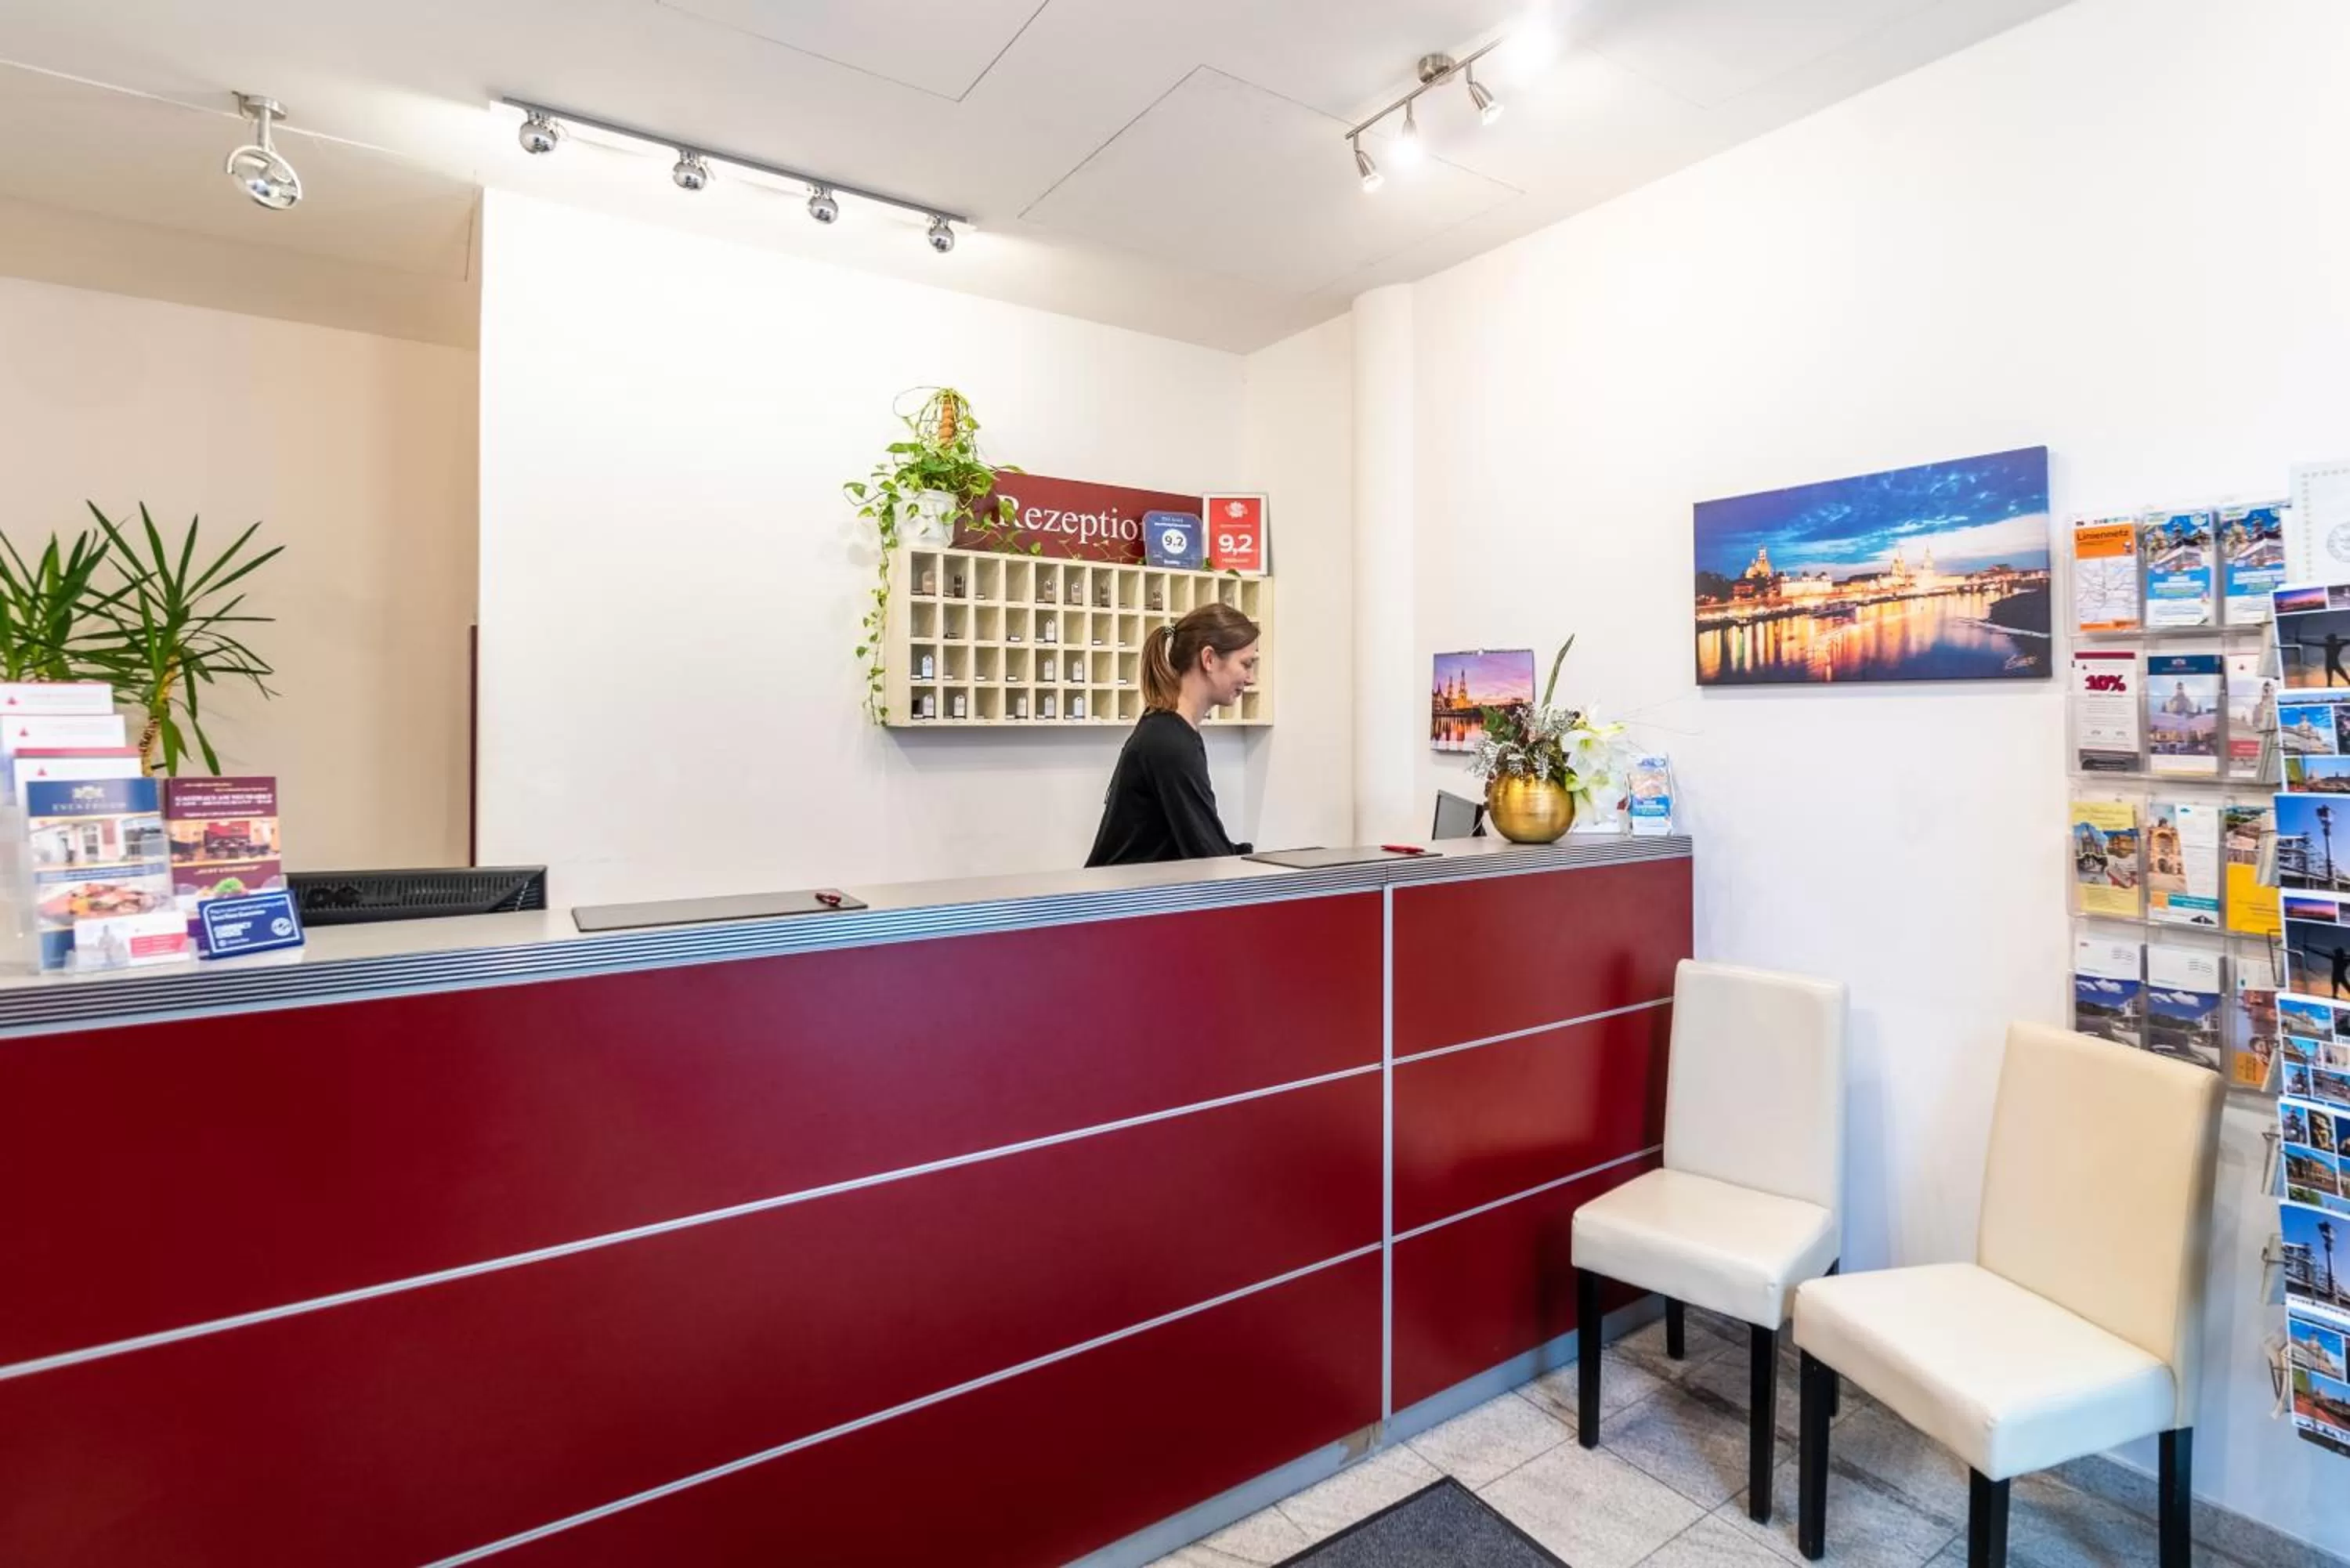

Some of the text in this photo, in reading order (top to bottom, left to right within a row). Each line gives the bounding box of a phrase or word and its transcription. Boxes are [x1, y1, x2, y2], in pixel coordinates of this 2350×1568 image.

[996, 493, 1144, 545] Rezeptio
[1164, 535, 1184, 547] 9.2
[1217, 533, 1254, 556] 9,2
[2084, 674, 2127, 692] 10%
